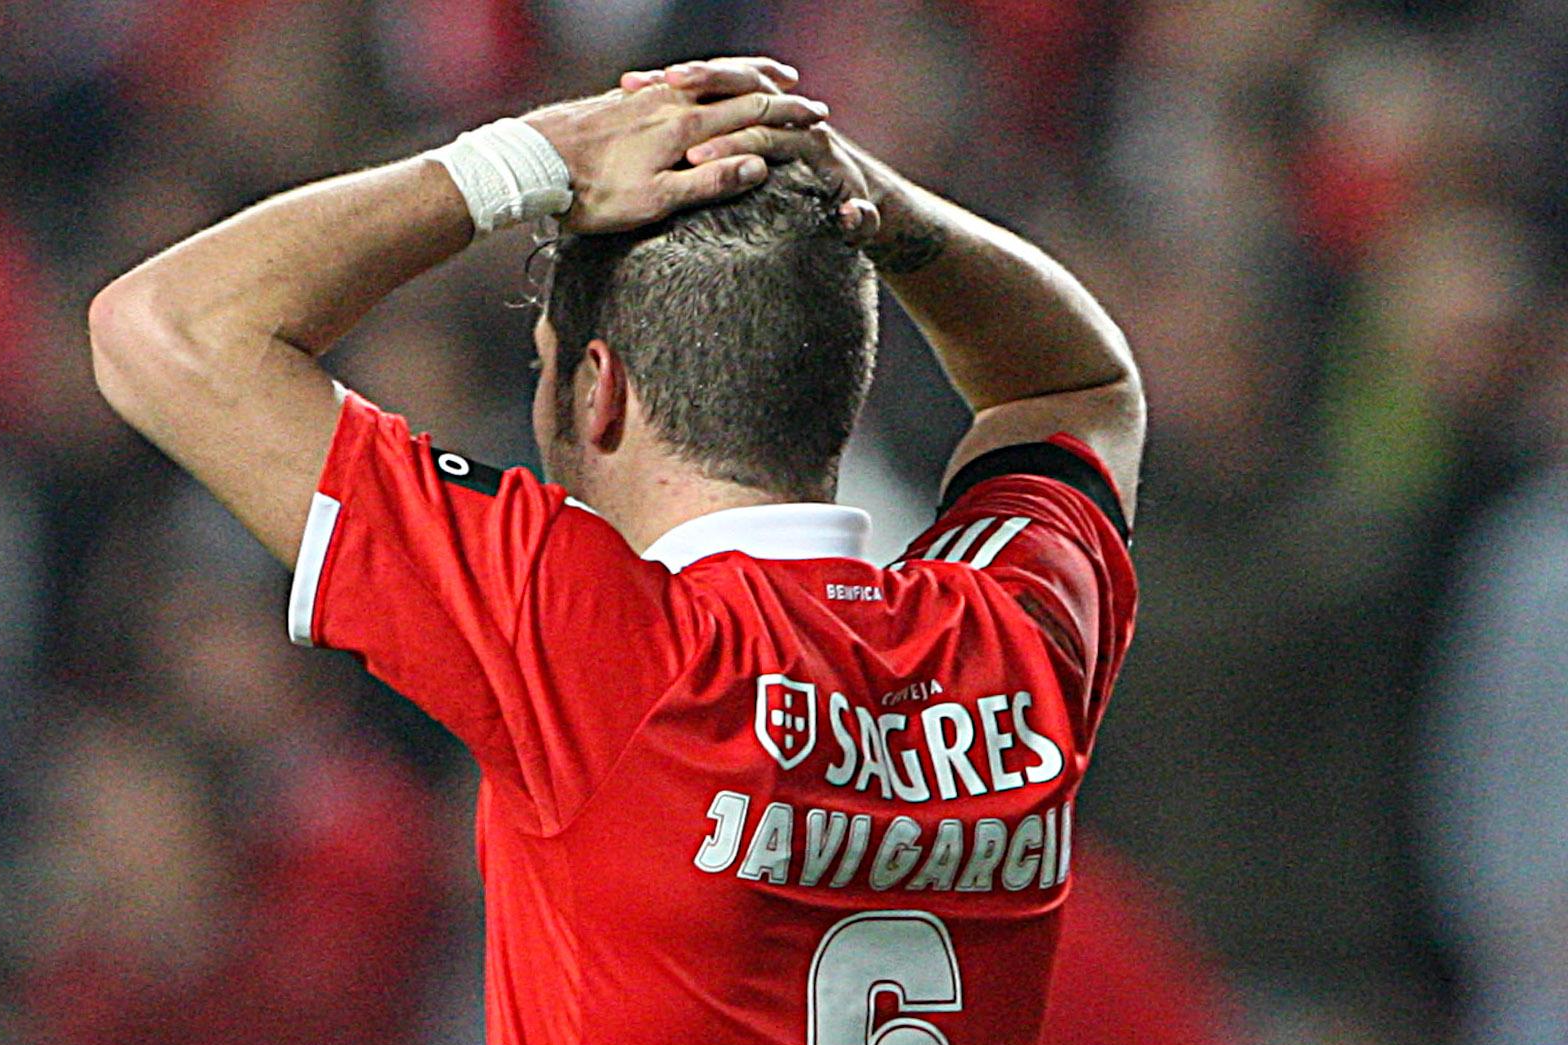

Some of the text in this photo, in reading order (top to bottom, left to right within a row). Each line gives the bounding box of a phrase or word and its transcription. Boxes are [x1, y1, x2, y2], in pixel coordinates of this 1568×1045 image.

[826, 583, 883, 601] BENFICA
[825, 691, 1065, 802] SAGRES
[693, 790, 871, 888] JAVI
